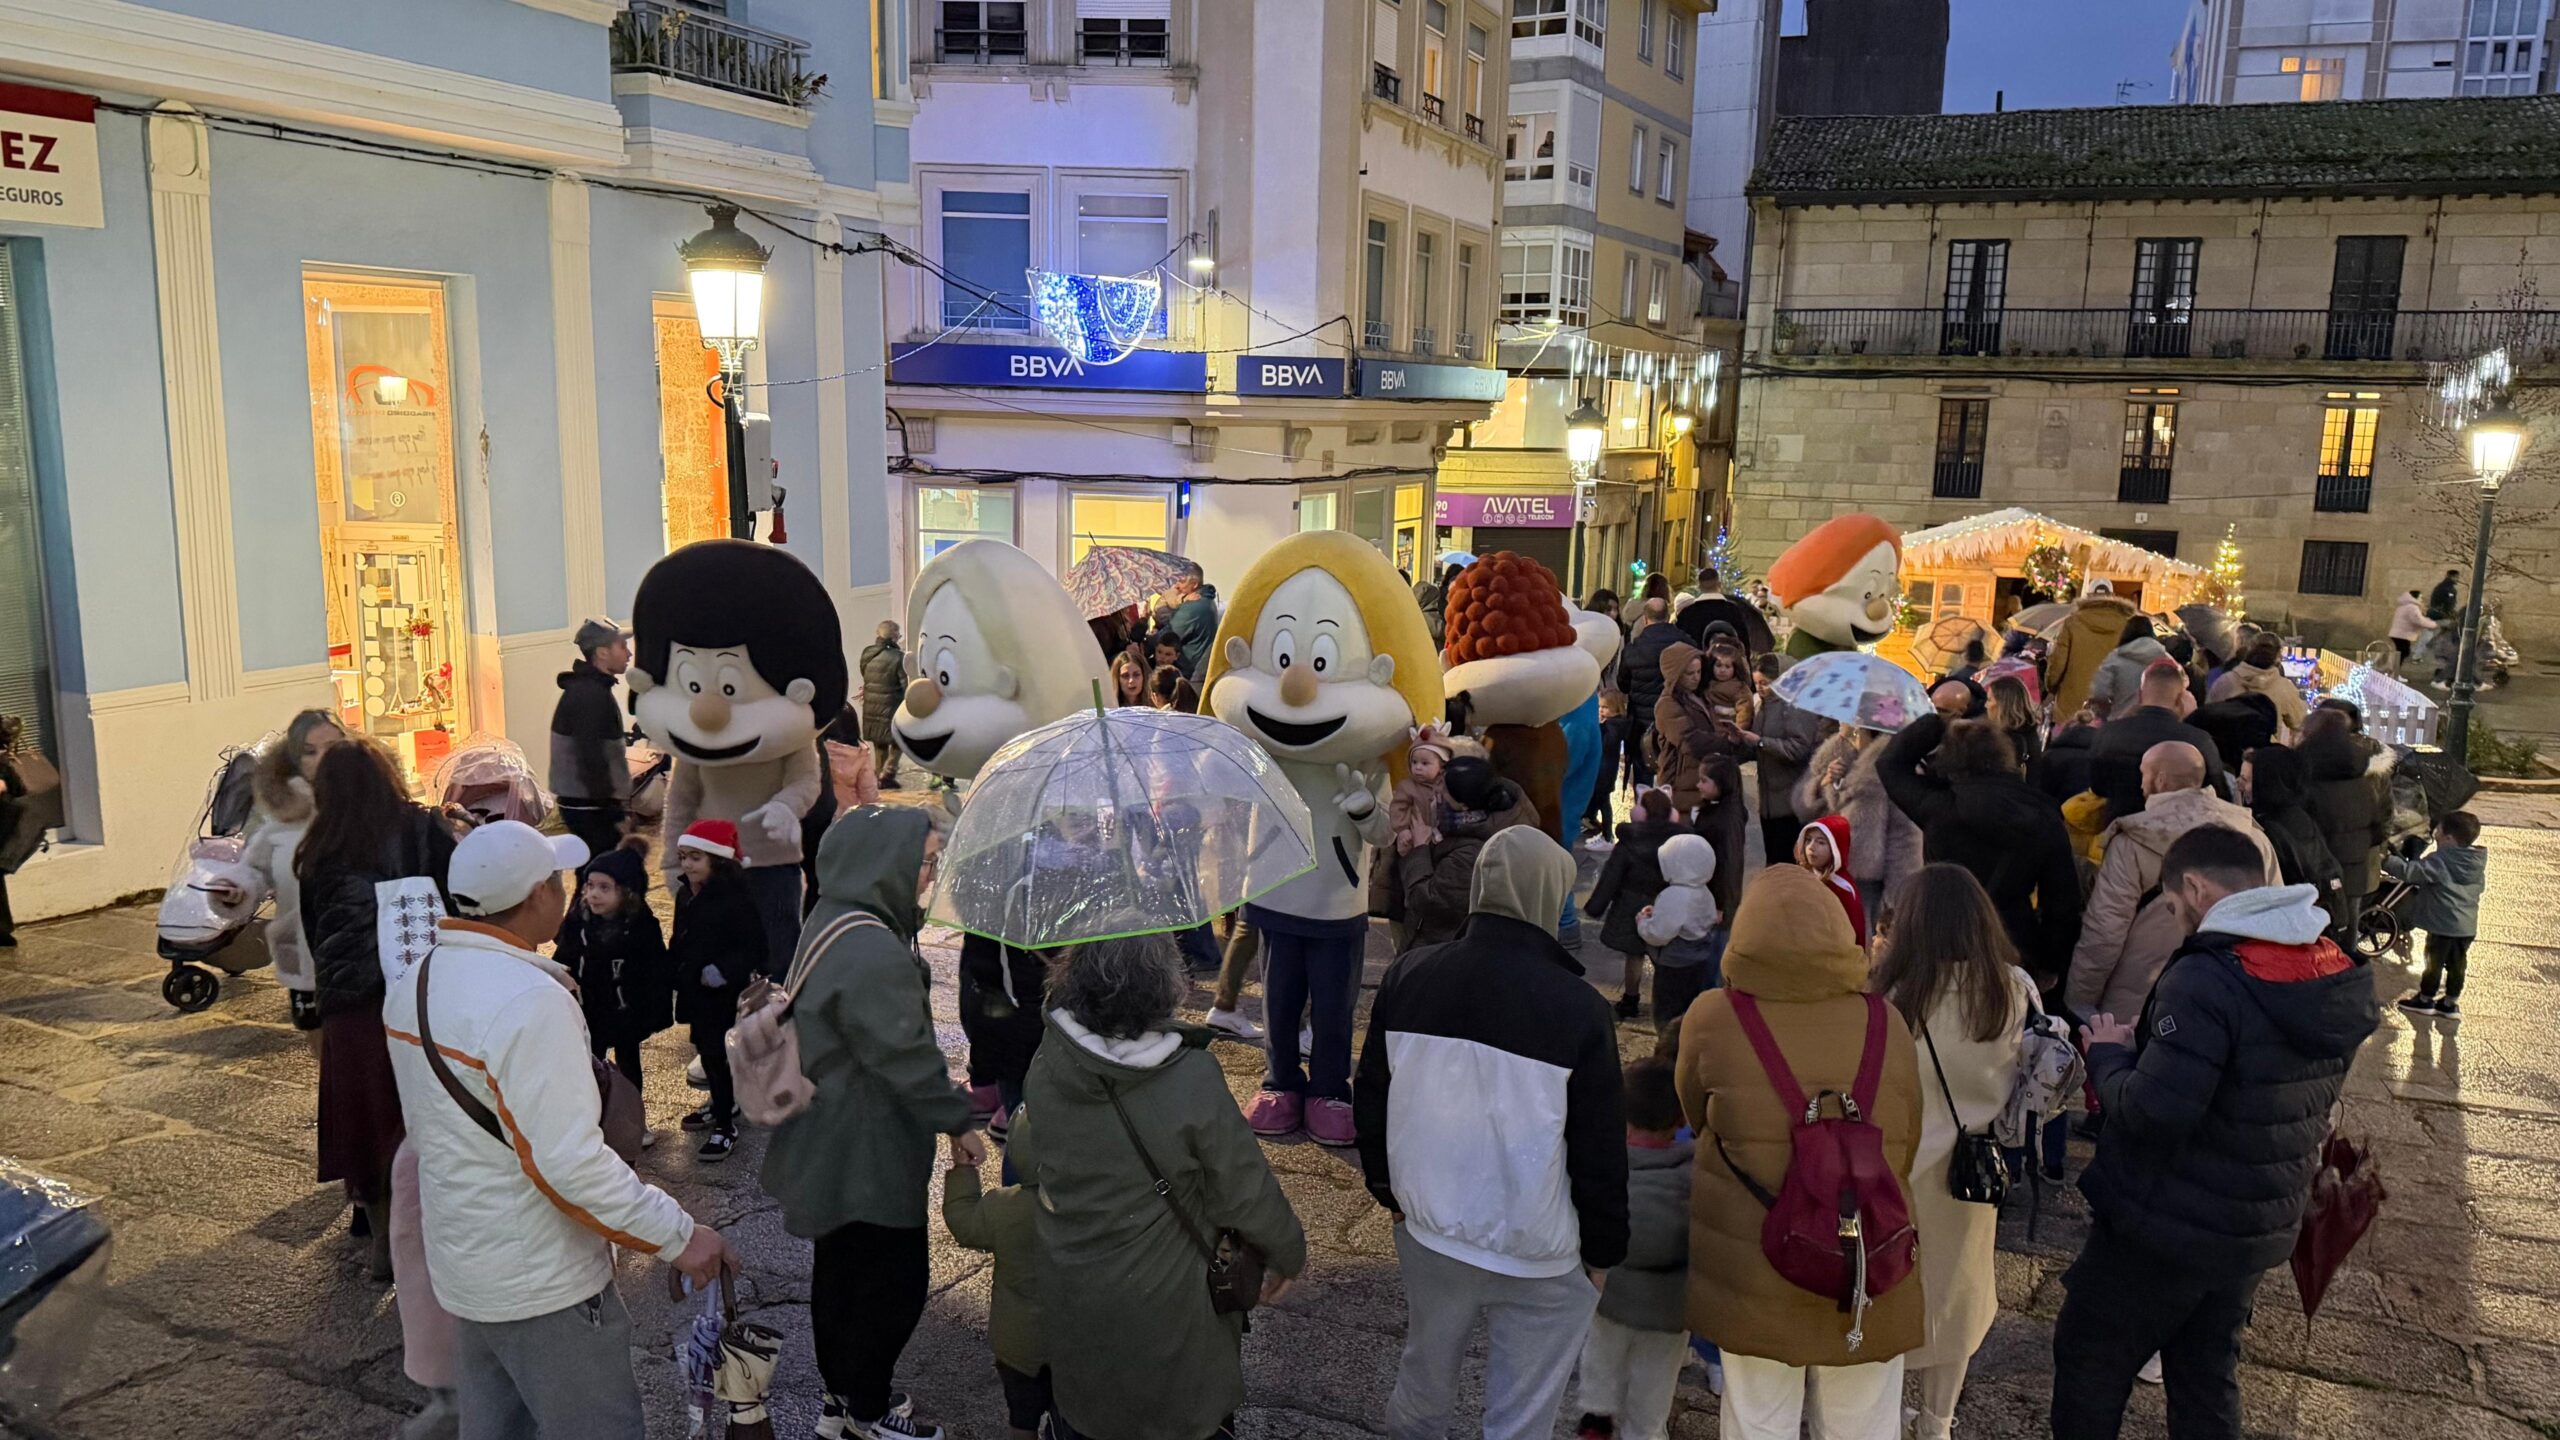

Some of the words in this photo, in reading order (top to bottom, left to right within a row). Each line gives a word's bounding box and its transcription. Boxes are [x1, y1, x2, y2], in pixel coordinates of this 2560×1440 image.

[0, 131, 60, 174] EZ
[1010, 355, 1085, 378] BBVA
[1261, 364, 1323, 387] BBVA
[1381, 368, 1405, 390] BBVA
[1483, 497, 1554, 514] AVATEL
